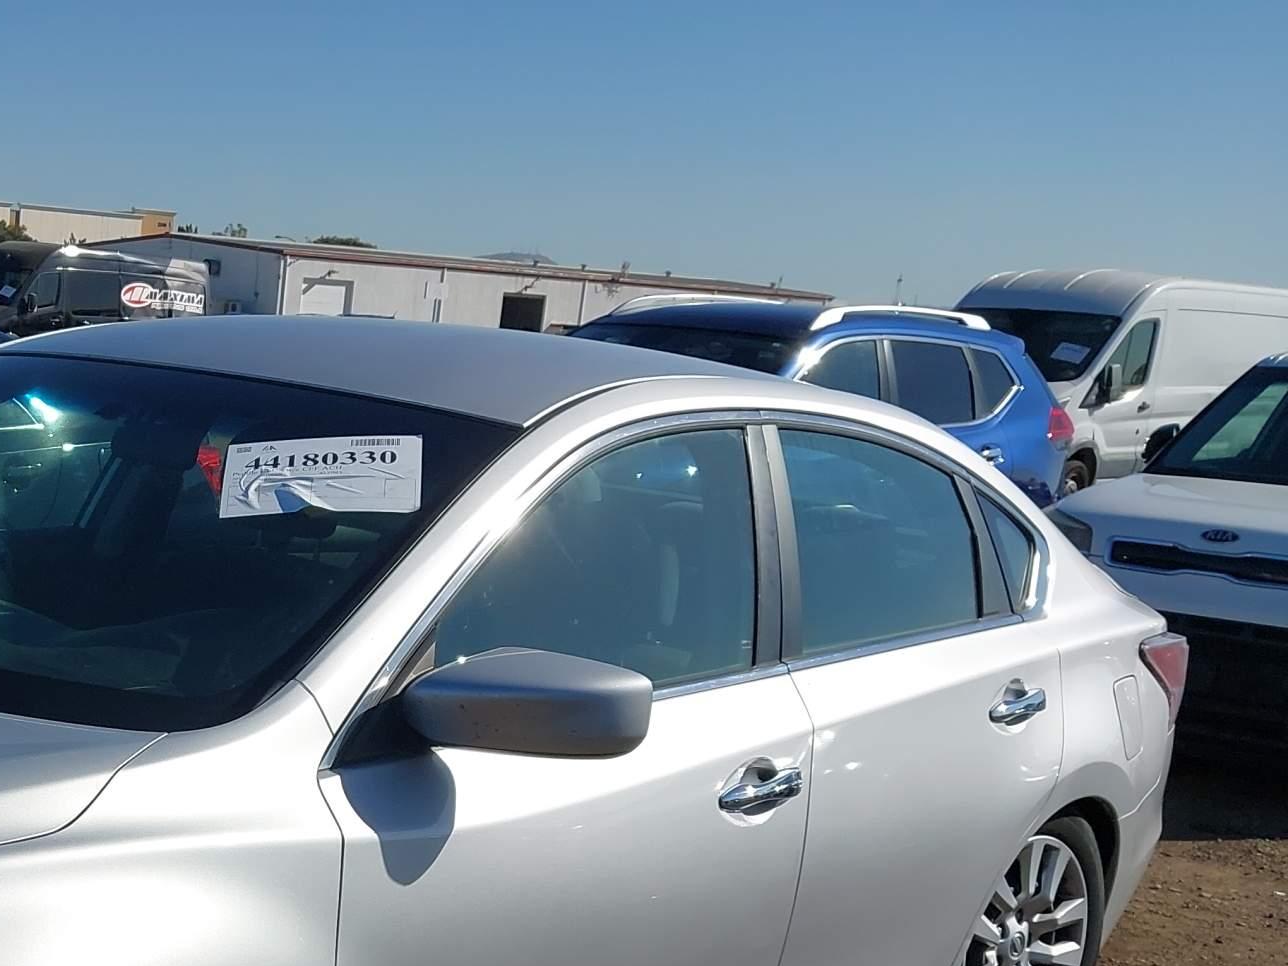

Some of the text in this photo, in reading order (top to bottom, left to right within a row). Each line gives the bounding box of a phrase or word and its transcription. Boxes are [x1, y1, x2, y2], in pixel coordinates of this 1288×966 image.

[146, 289, 205, 306] MAXIMA
[245, 450, 397, 469] 44180330
[1204, 530, 1234, 541] KIA
